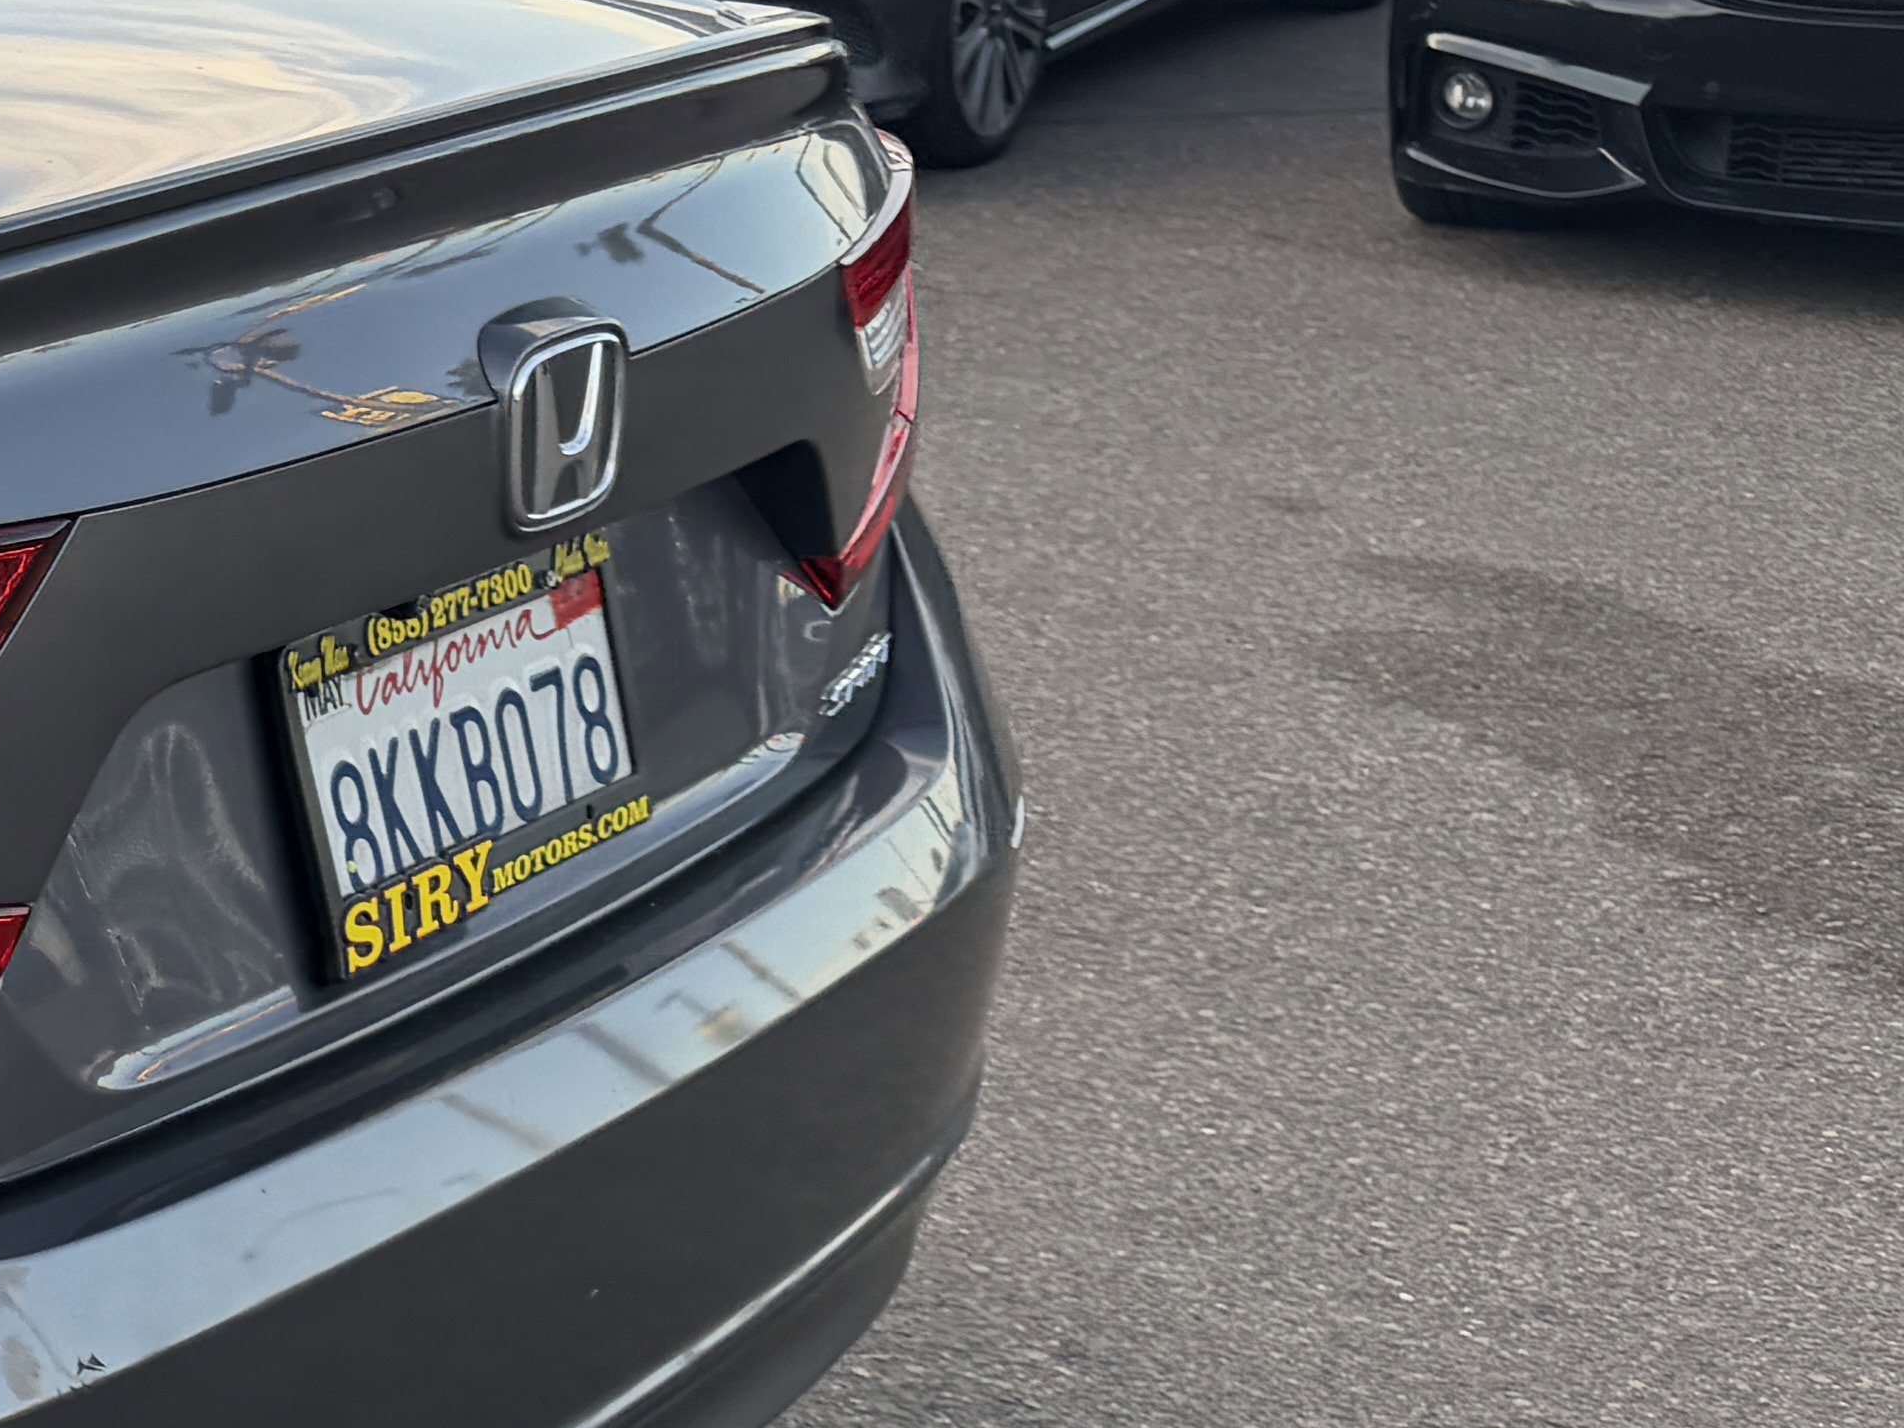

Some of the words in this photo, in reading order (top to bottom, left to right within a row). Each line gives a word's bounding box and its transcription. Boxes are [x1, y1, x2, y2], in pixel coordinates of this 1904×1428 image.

[430, 563, 533, 629] 277-7300
[302, 675, 344, 721] MAY
[355, 608, 558, 716] California
[330, 653, 619, 892] 8KKB078
[344, 839, 493, 973] SIRY
[492, 795, 651, 894] MOTORS.COM
